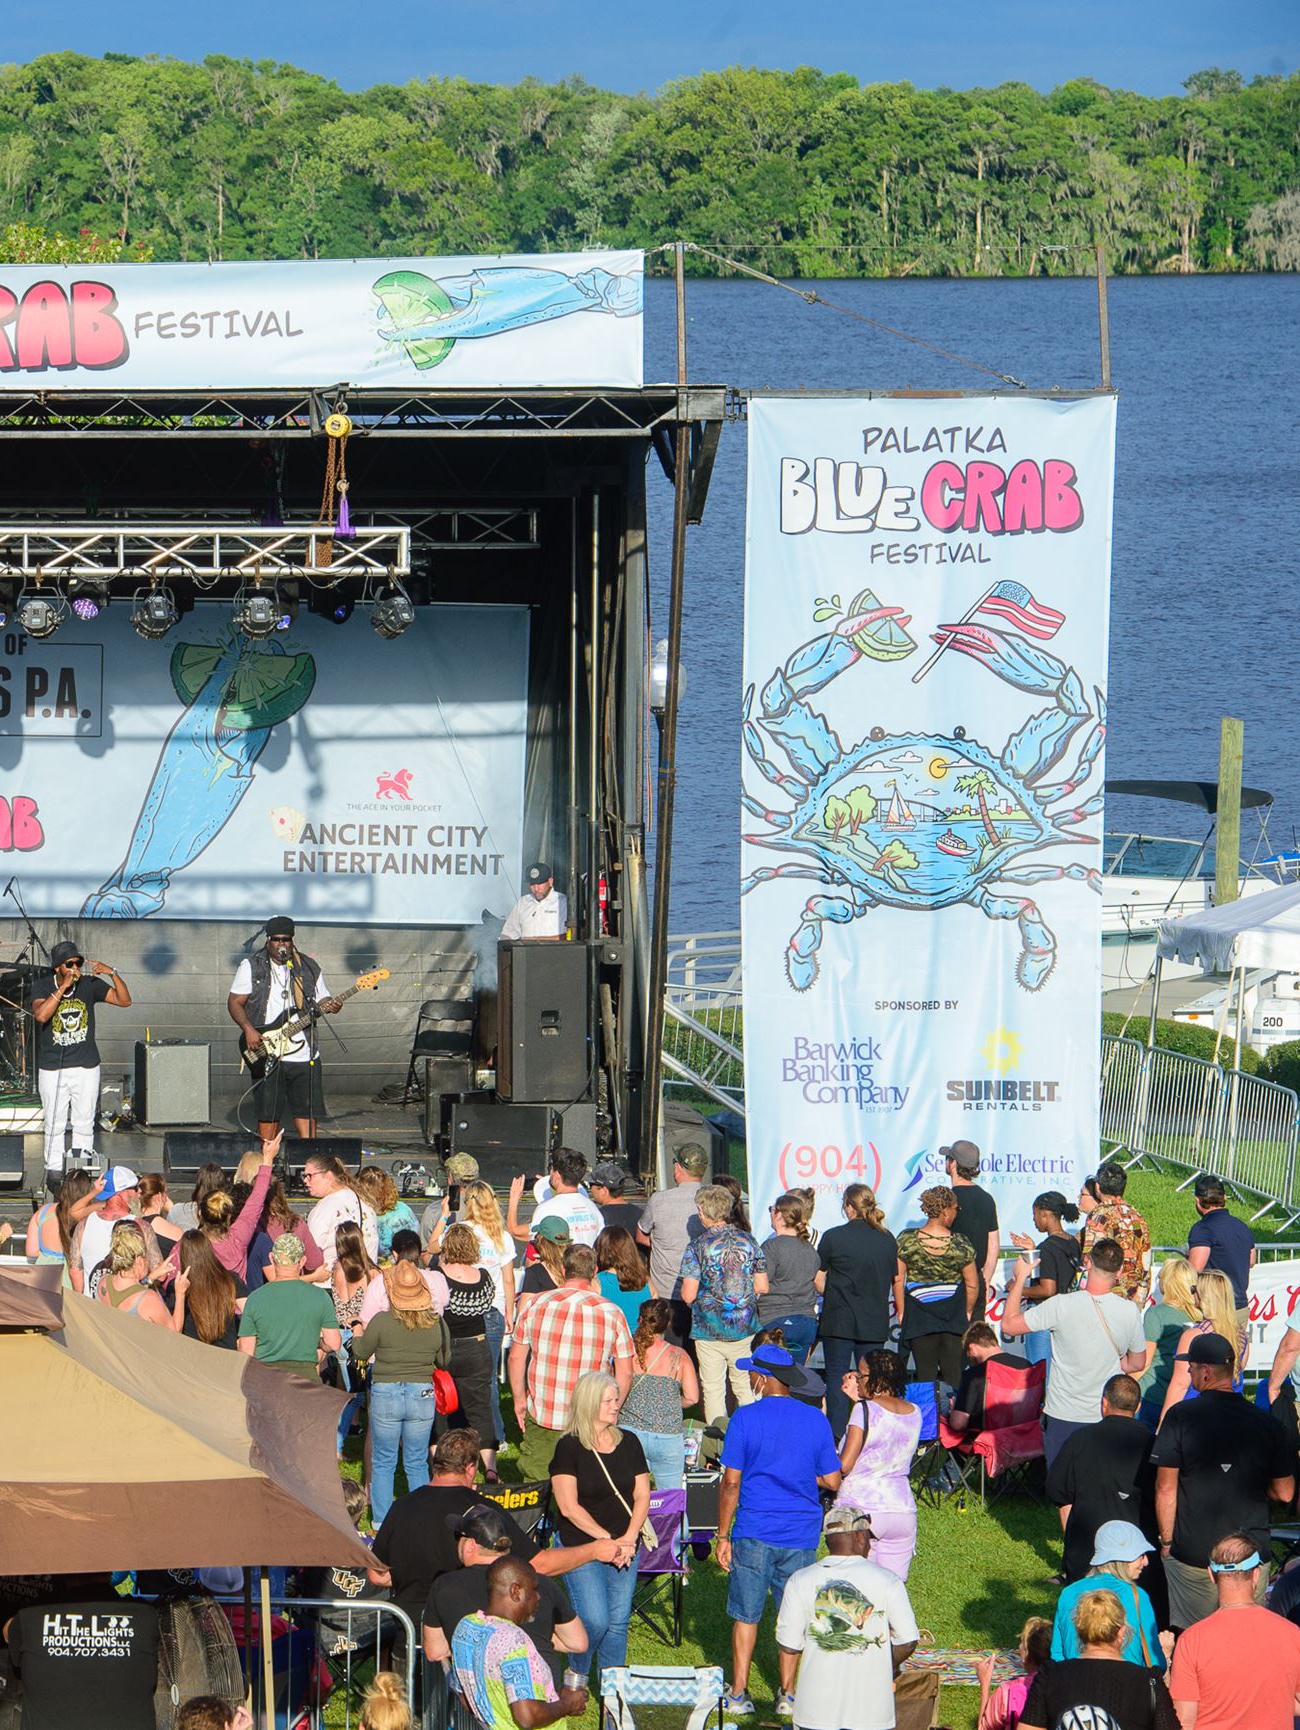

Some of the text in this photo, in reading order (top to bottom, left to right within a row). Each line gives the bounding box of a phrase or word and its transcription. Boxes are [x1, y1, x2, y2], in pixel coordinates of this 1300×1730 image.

[134, 310, 304, 339] FESTIVAL
[862, 426, 1008, 454] PALATKA
[780, 457, 1084, 536] BLUE CRAB
[870, 542, 991, 564] FESTIVAL
[25, 667, 92, 719] P.A.
[348, 803, 362, 811] THE
[364, 803, 378, 811] ACE
[413, 804, 442, 812] POCKET
[299, 823, 489, 848] ANCIENT CITY
[283, 851, 504, 876] ENTERTAINMENT
[875, 1000, 959, 1011] SPONSORED BY
[1262, 1017, 1283, 1027] 200
[794, 1036, 883, 1061] Barwick
[782, 1058, 875, 1089] Banking
[803, 1081, 910, 1110] Company
[946, 1080, 1059, 1102] SUNBELT
[963, 1102, 1042, 1112] RENTALS
[779, 1141, 882, 1194] (904)
[925, 1153, 1075, 1173] Seole Electric
[484, 1488, 539, 1509] elers
[332, 1567, 366, 1597] UCF
[43, 1636, 117, 1647] PRODUCTIONS
[48, 1647, 131, 1657] 904.707.3431
